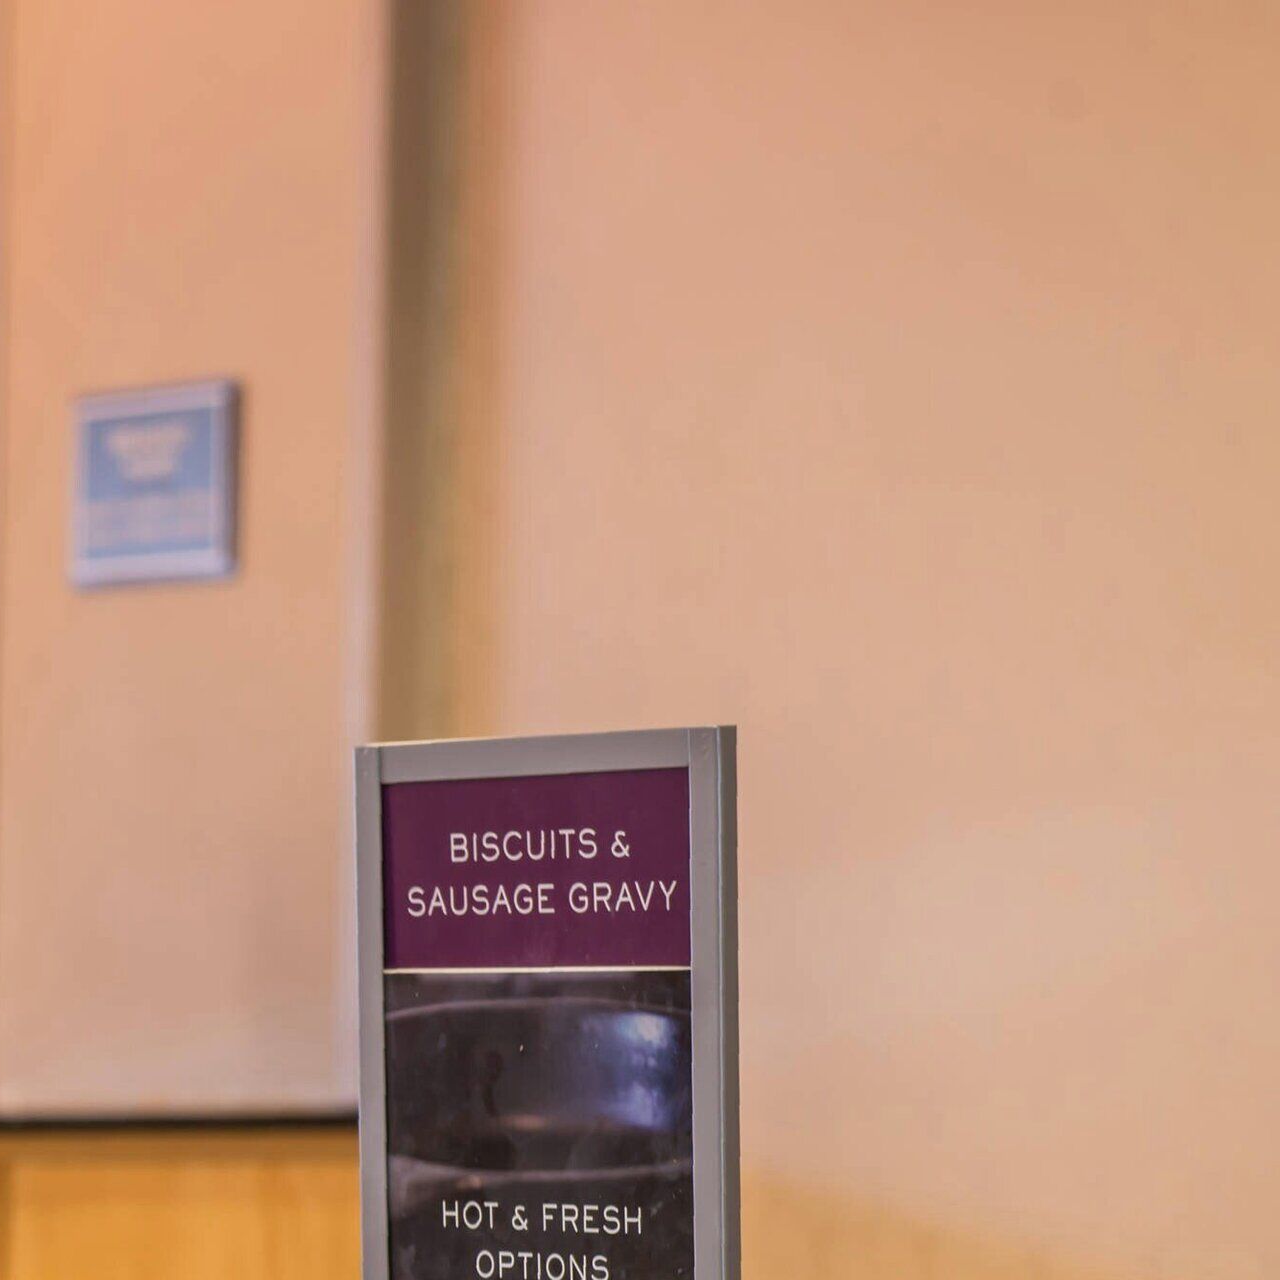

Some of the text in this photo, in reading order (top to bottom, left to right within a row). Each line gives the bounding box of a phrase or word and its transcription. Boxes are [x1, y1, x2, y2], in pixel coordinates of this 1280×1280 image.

[449, 827, 631, 863] BISCUITS &
[406, 879, 678, 917] SAUSAGE GRAVY
[441, 1199, 643, 1235] HOT & FRESH
